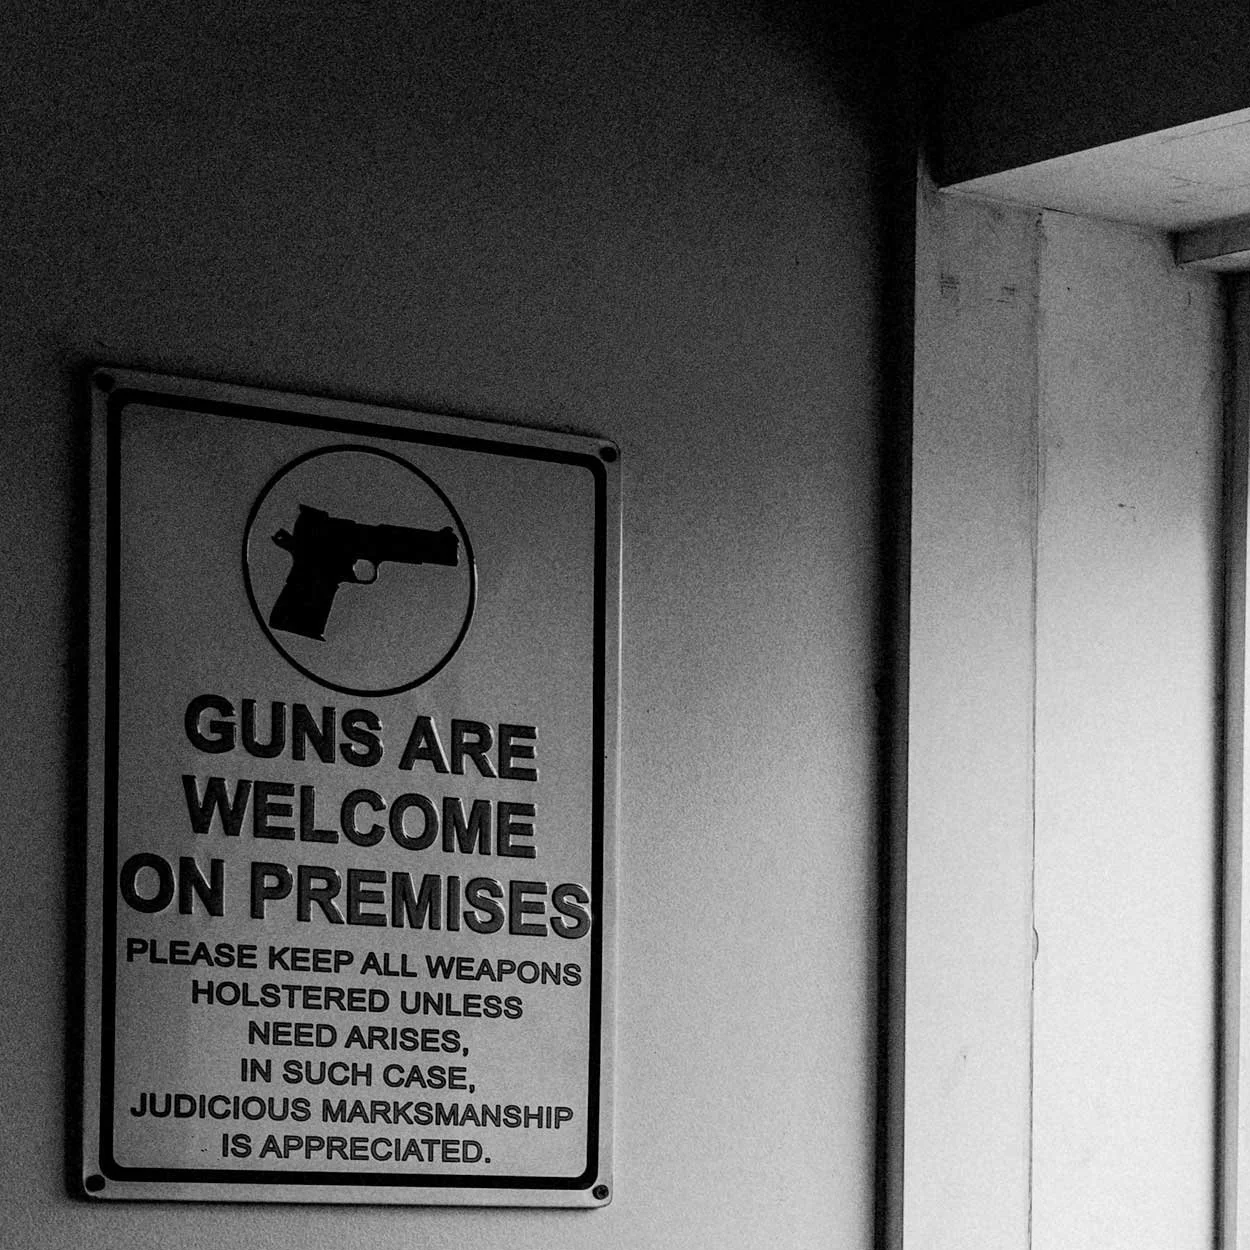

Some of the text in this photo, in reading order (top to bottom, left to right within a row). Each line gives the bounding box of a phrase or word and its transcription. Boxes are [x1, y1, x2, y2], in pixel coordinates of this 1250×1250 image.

[184, 694, 540, 781] GUNS ARE
[182, 775, 538, 859] WELCOME
[119, 852, 592, 939] ON PREMISES
[125, 938, 583, 986] PLEASE KEEP ALL WEAPONS
[191, 979, 523, 1019] HOLSTERED UNLESS
[248, 1021, 470, 1057] NEED ARISES,
[240, 1058, 476, 1093] IN SUCH CASE,
[130, 1093, 574, 1129] JUDICIOUS MARKSMANSHIP
[221, 1133, 492, 1164] IS APPRECIATED.
